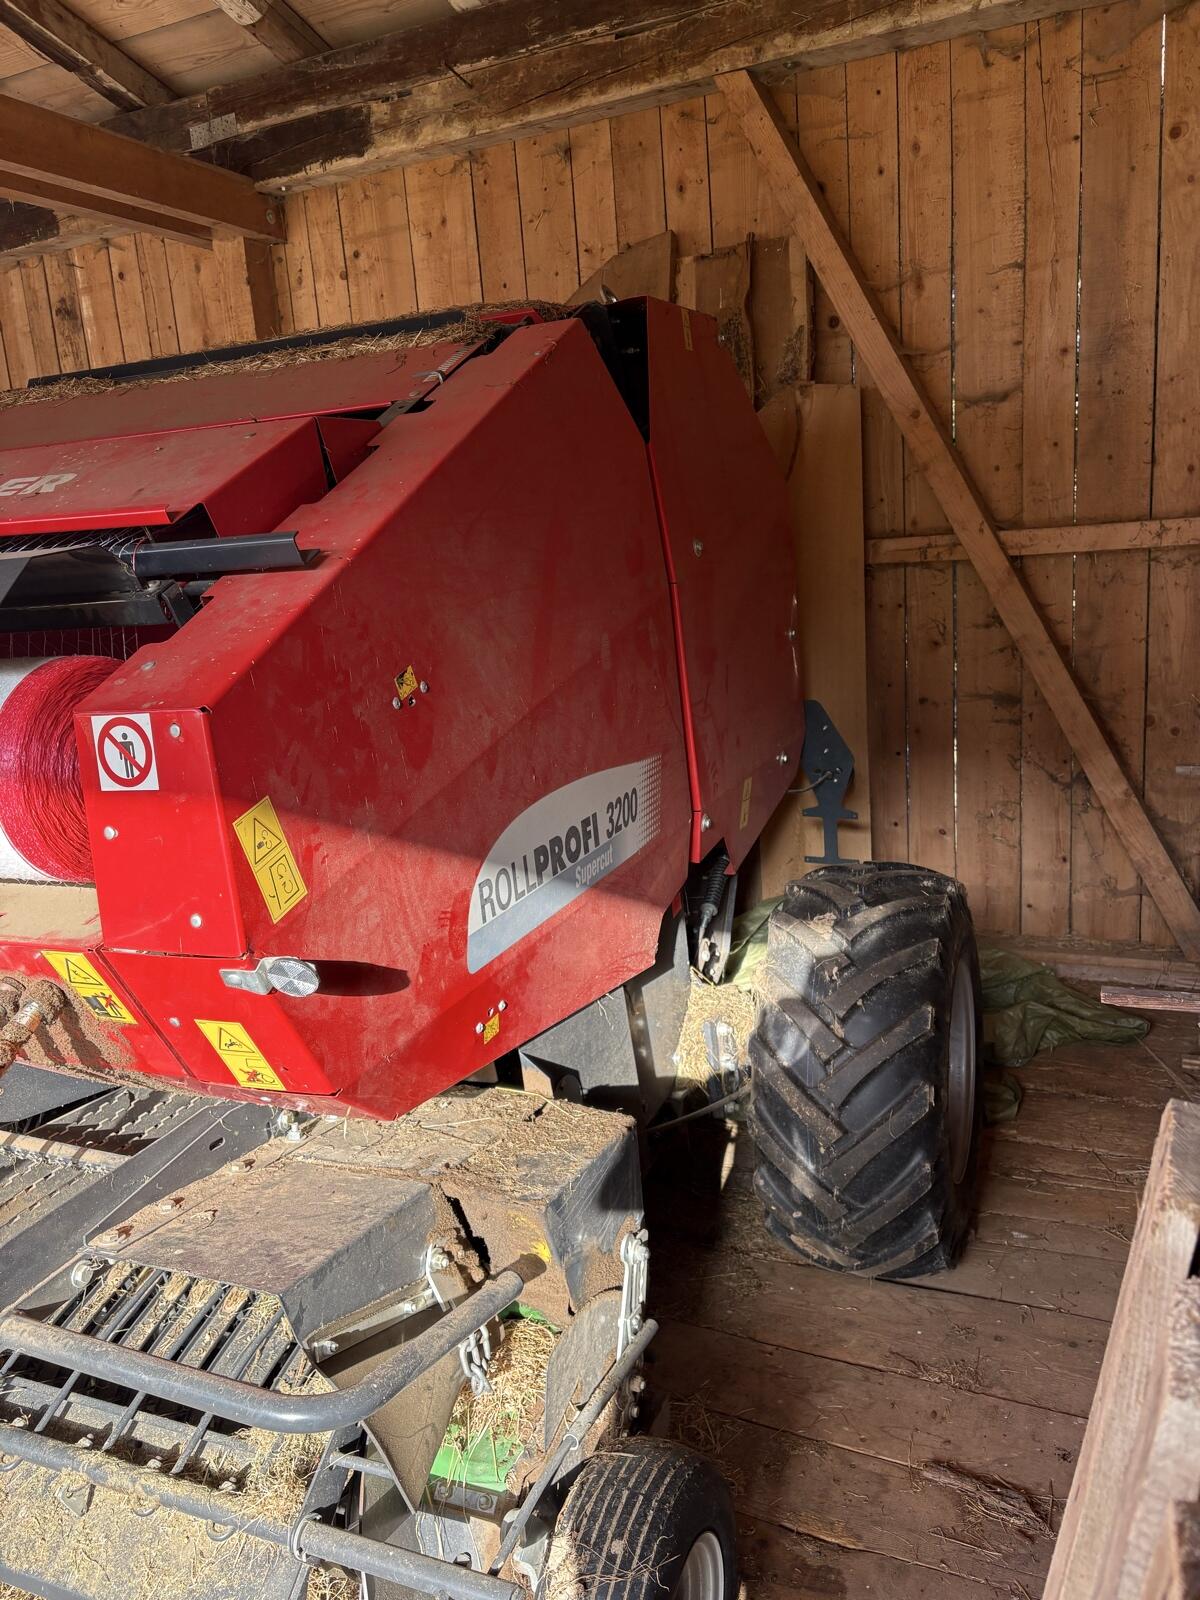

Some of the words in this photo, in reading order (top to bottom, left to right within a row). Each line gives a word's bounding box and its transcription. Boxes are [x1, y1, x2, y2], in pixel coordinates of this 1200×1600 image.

[478, 813, 600, 924] ROLLPROFI
[606, 787, 638, 839] 3200
[575, 845, 613, 888] Supercut
